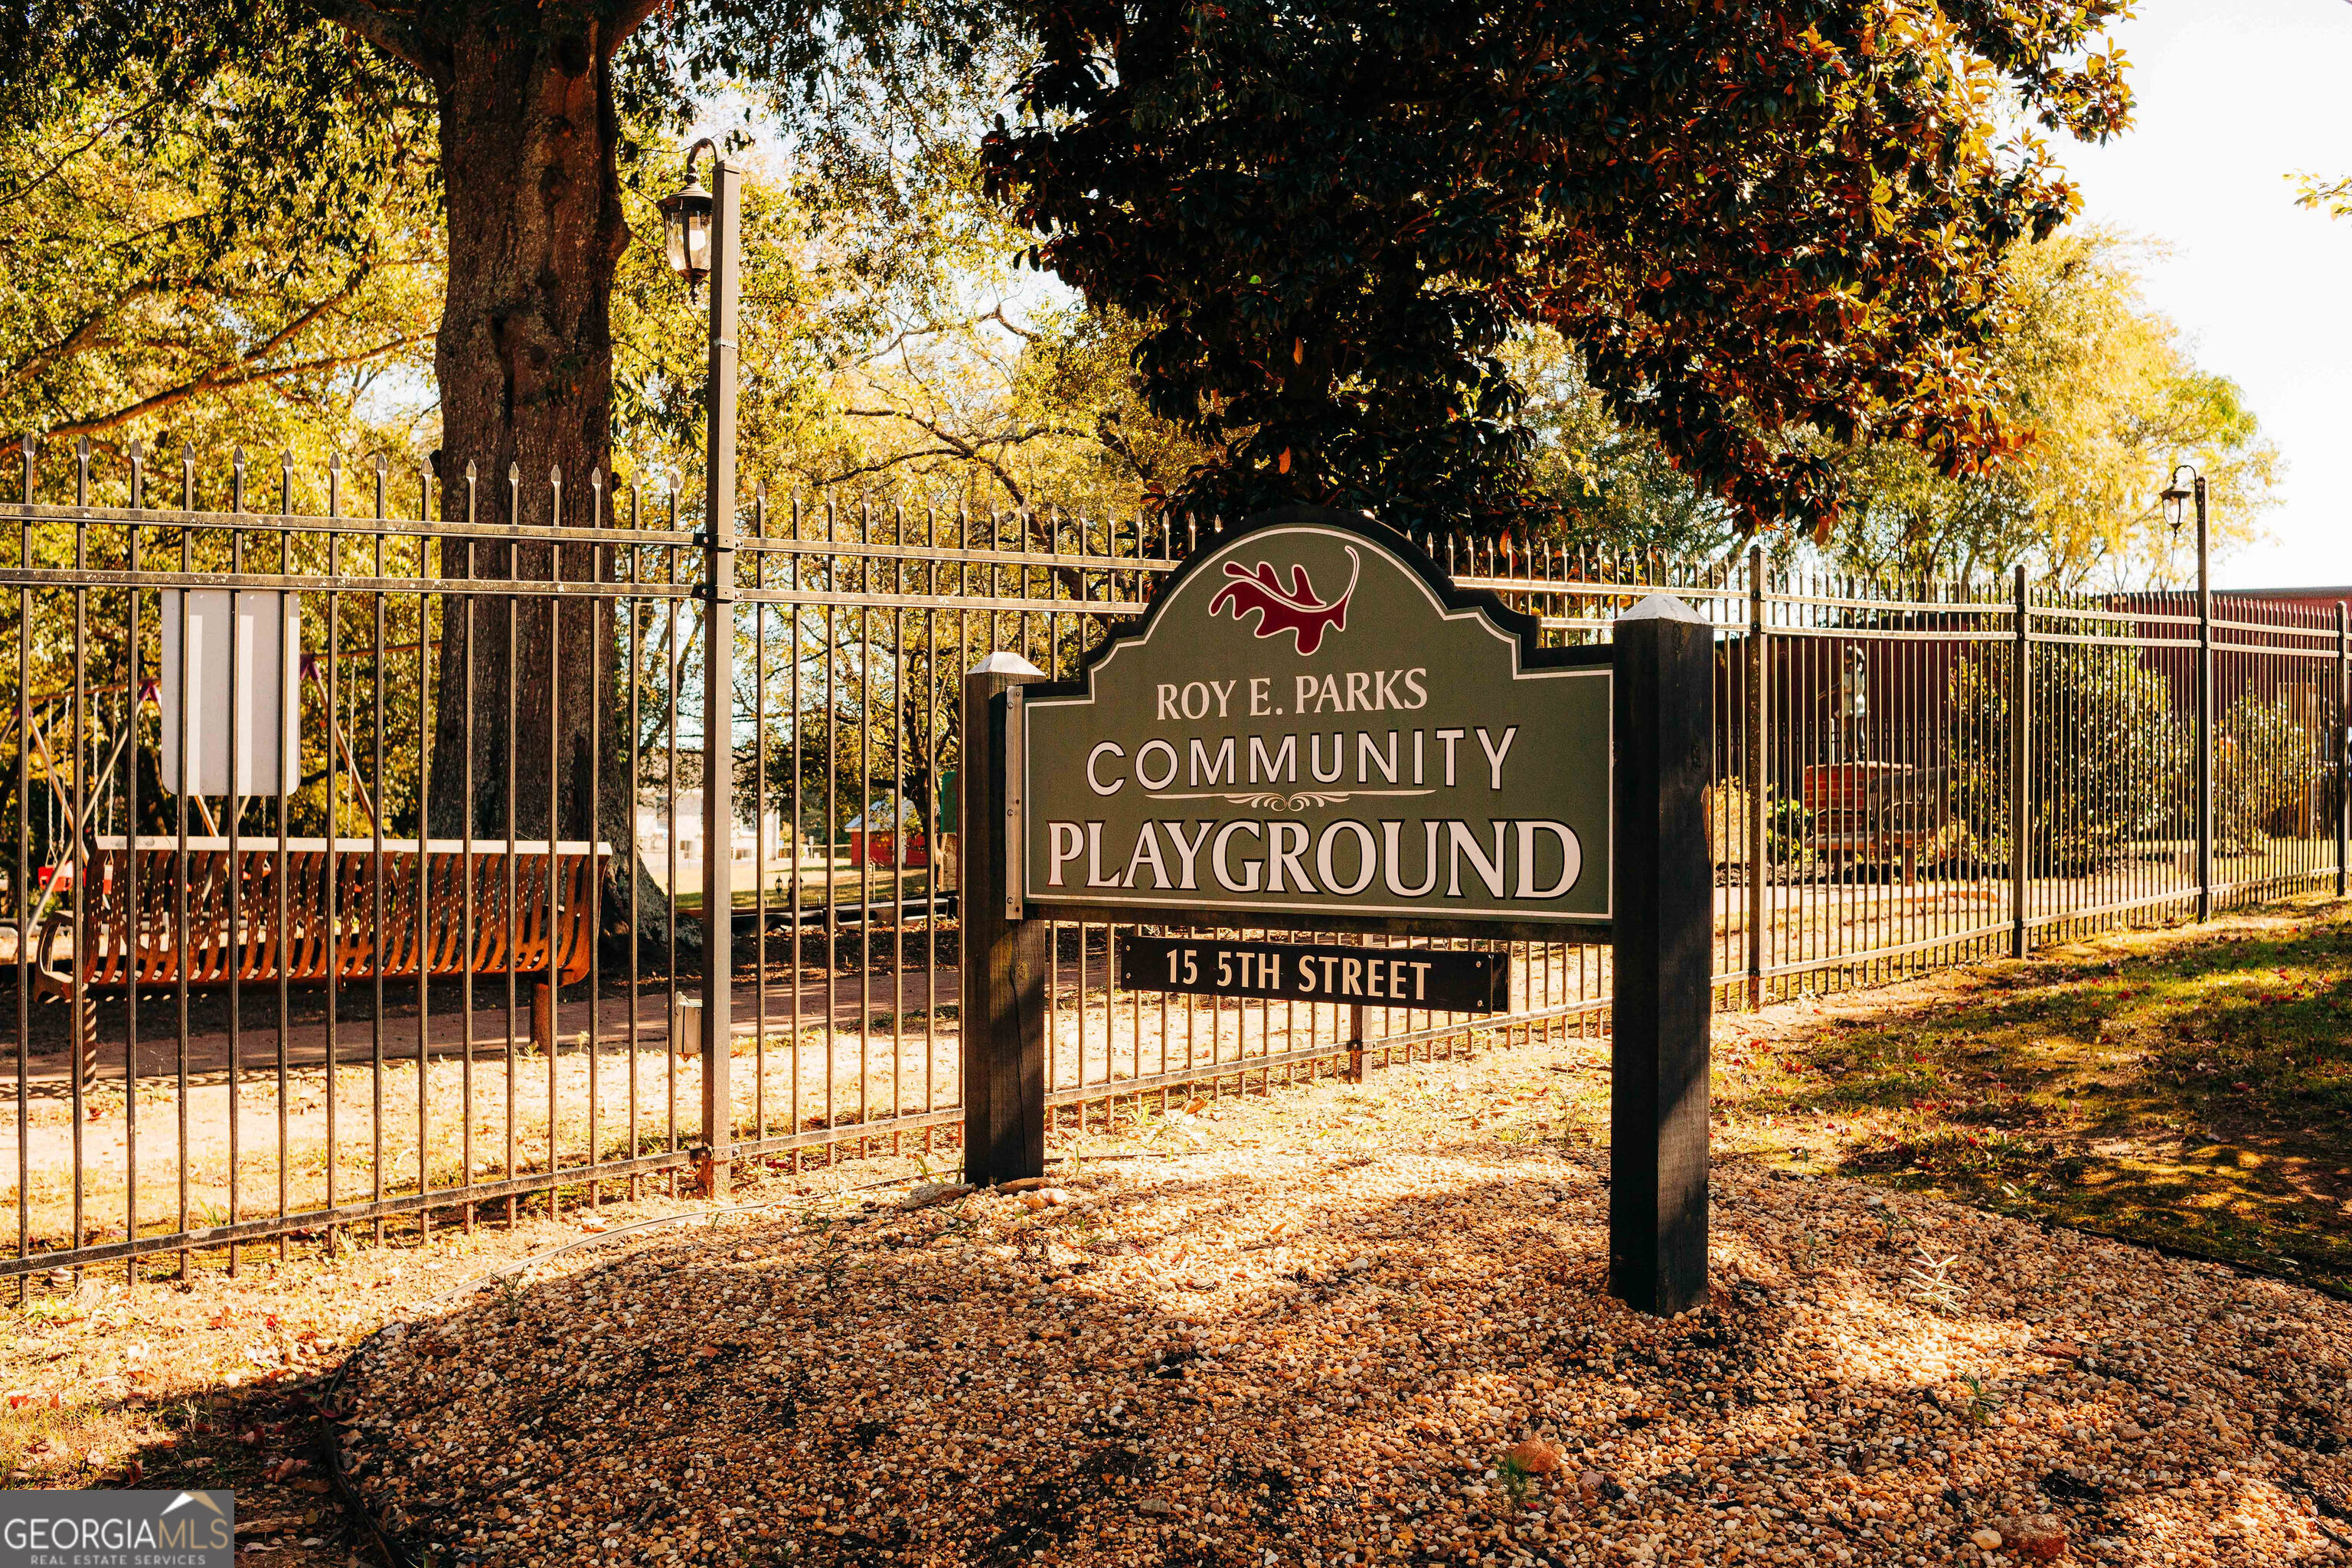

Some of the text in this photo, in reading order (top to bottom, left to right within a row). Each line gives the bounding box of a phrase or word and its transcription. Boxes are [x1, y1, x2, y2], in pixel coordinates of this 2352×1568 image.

[1156, 668, 1429, 721] ROY E. PARKS
[1086, 725, 1518, 797] COMMUNITY
[1046, 819, 1583, 900] PLAYGROUND
[1166, 949, 1432, 1001] 15 5TH STREET
